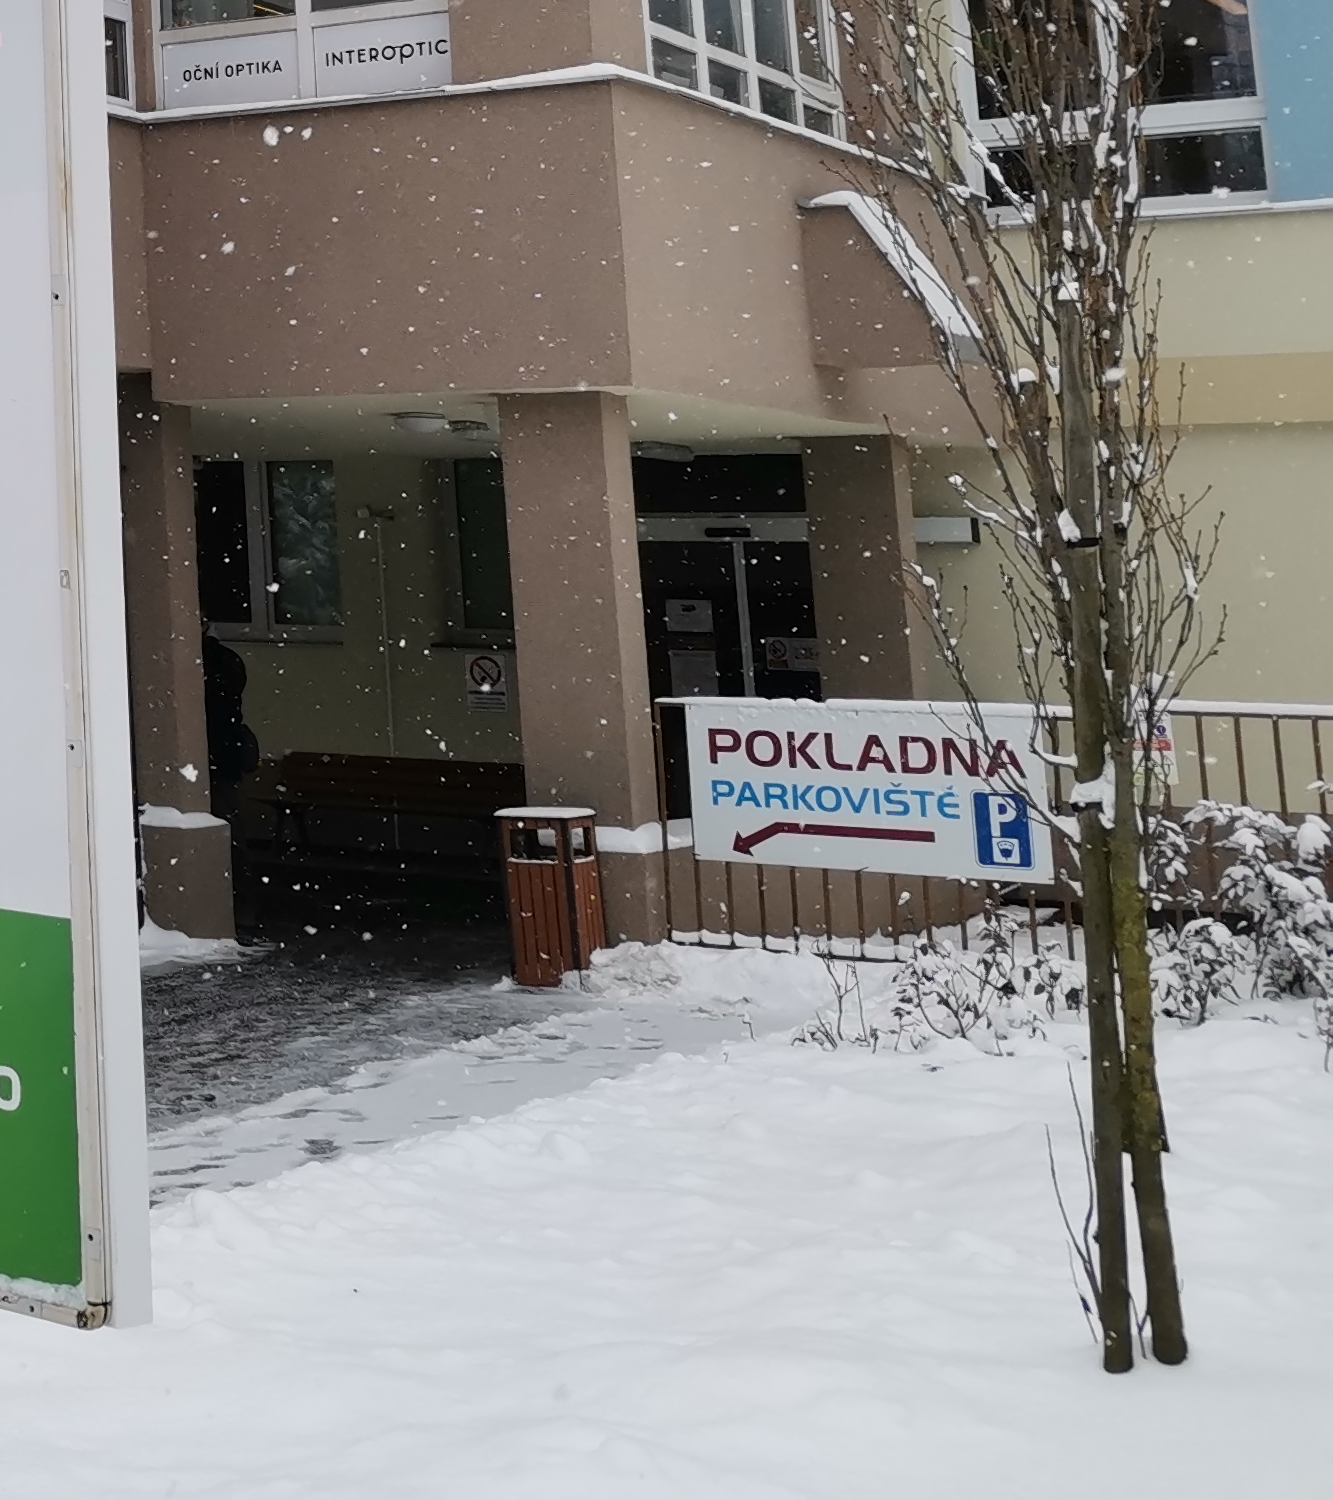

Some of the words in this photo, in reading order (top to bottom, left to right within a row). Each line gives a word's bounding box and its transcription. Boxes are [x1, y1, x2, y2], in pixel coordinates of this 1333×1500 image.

[181, 61, 220, 83] OČNÍ
[224, 59, 284, 78] OPTIKA
[707, 727, 1028, 779] POKLADNA
